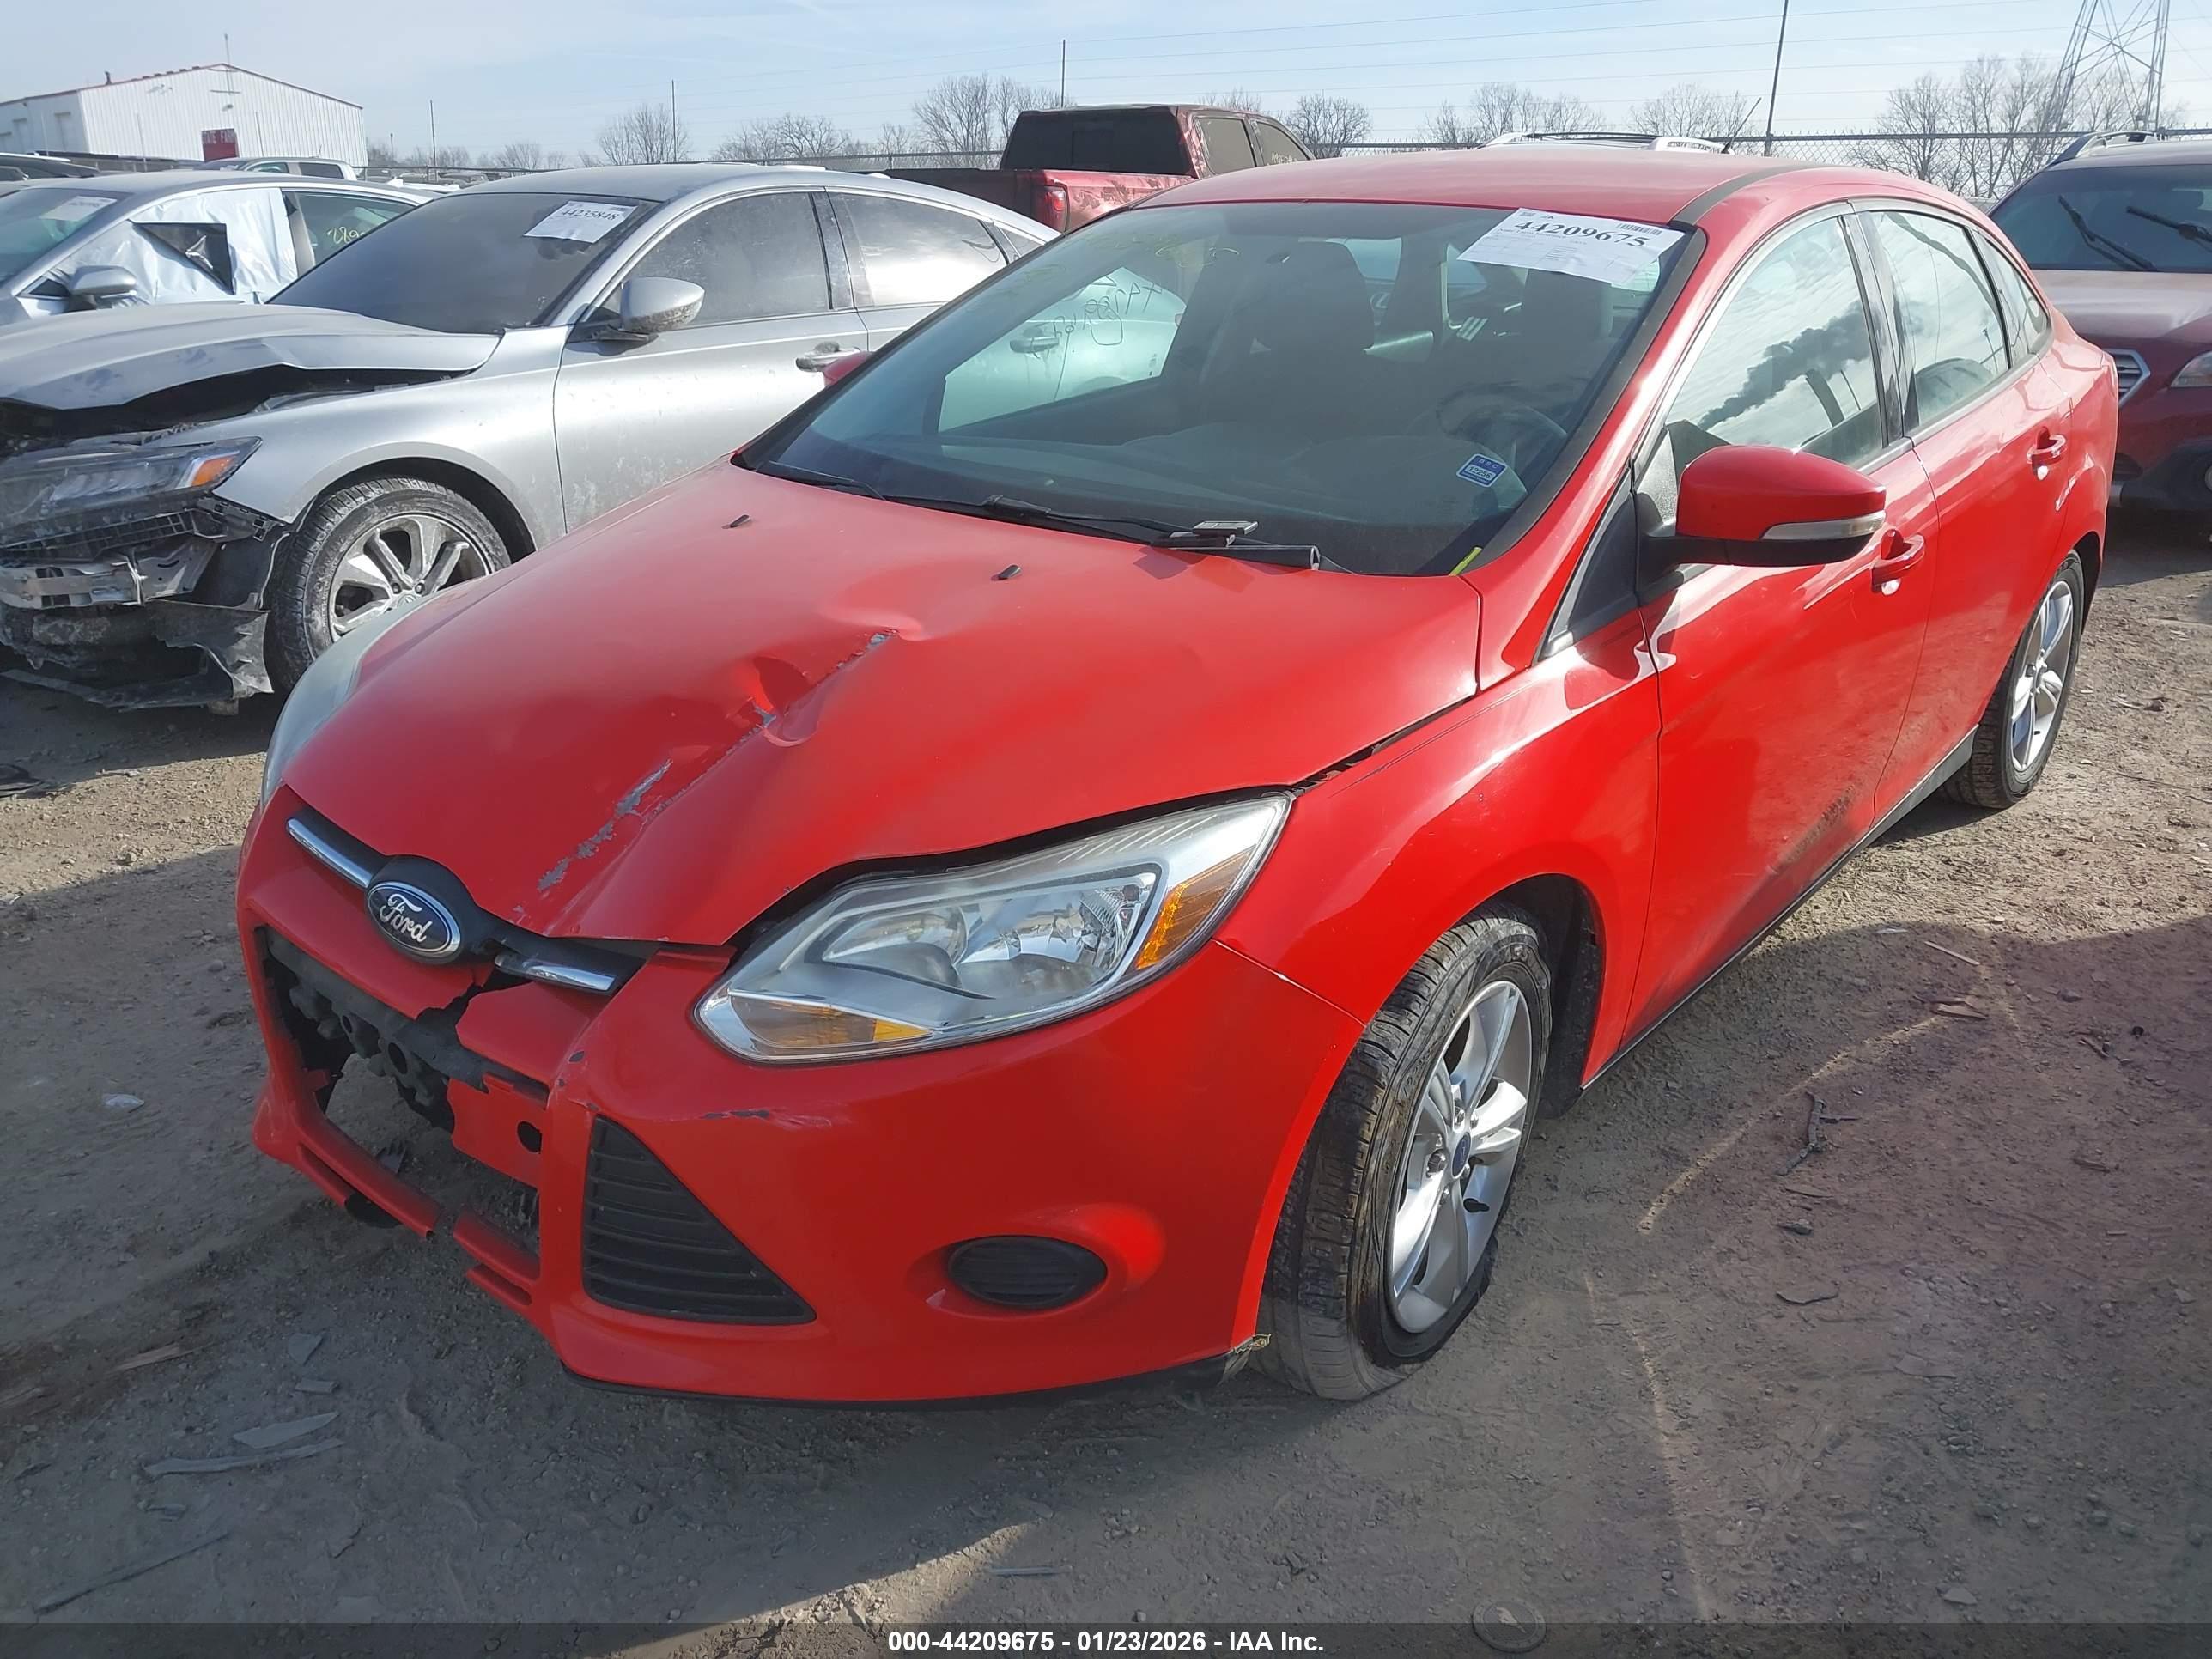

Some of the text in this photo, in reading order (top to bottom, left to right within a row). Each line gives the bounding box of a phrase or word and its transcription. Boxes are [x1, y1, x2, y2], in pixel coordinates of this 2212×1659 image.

[562, 209, 620, 221] 44235848
[1515, 221, 1651, 247] 44209675
[379, 893, 433, 943] Ford
